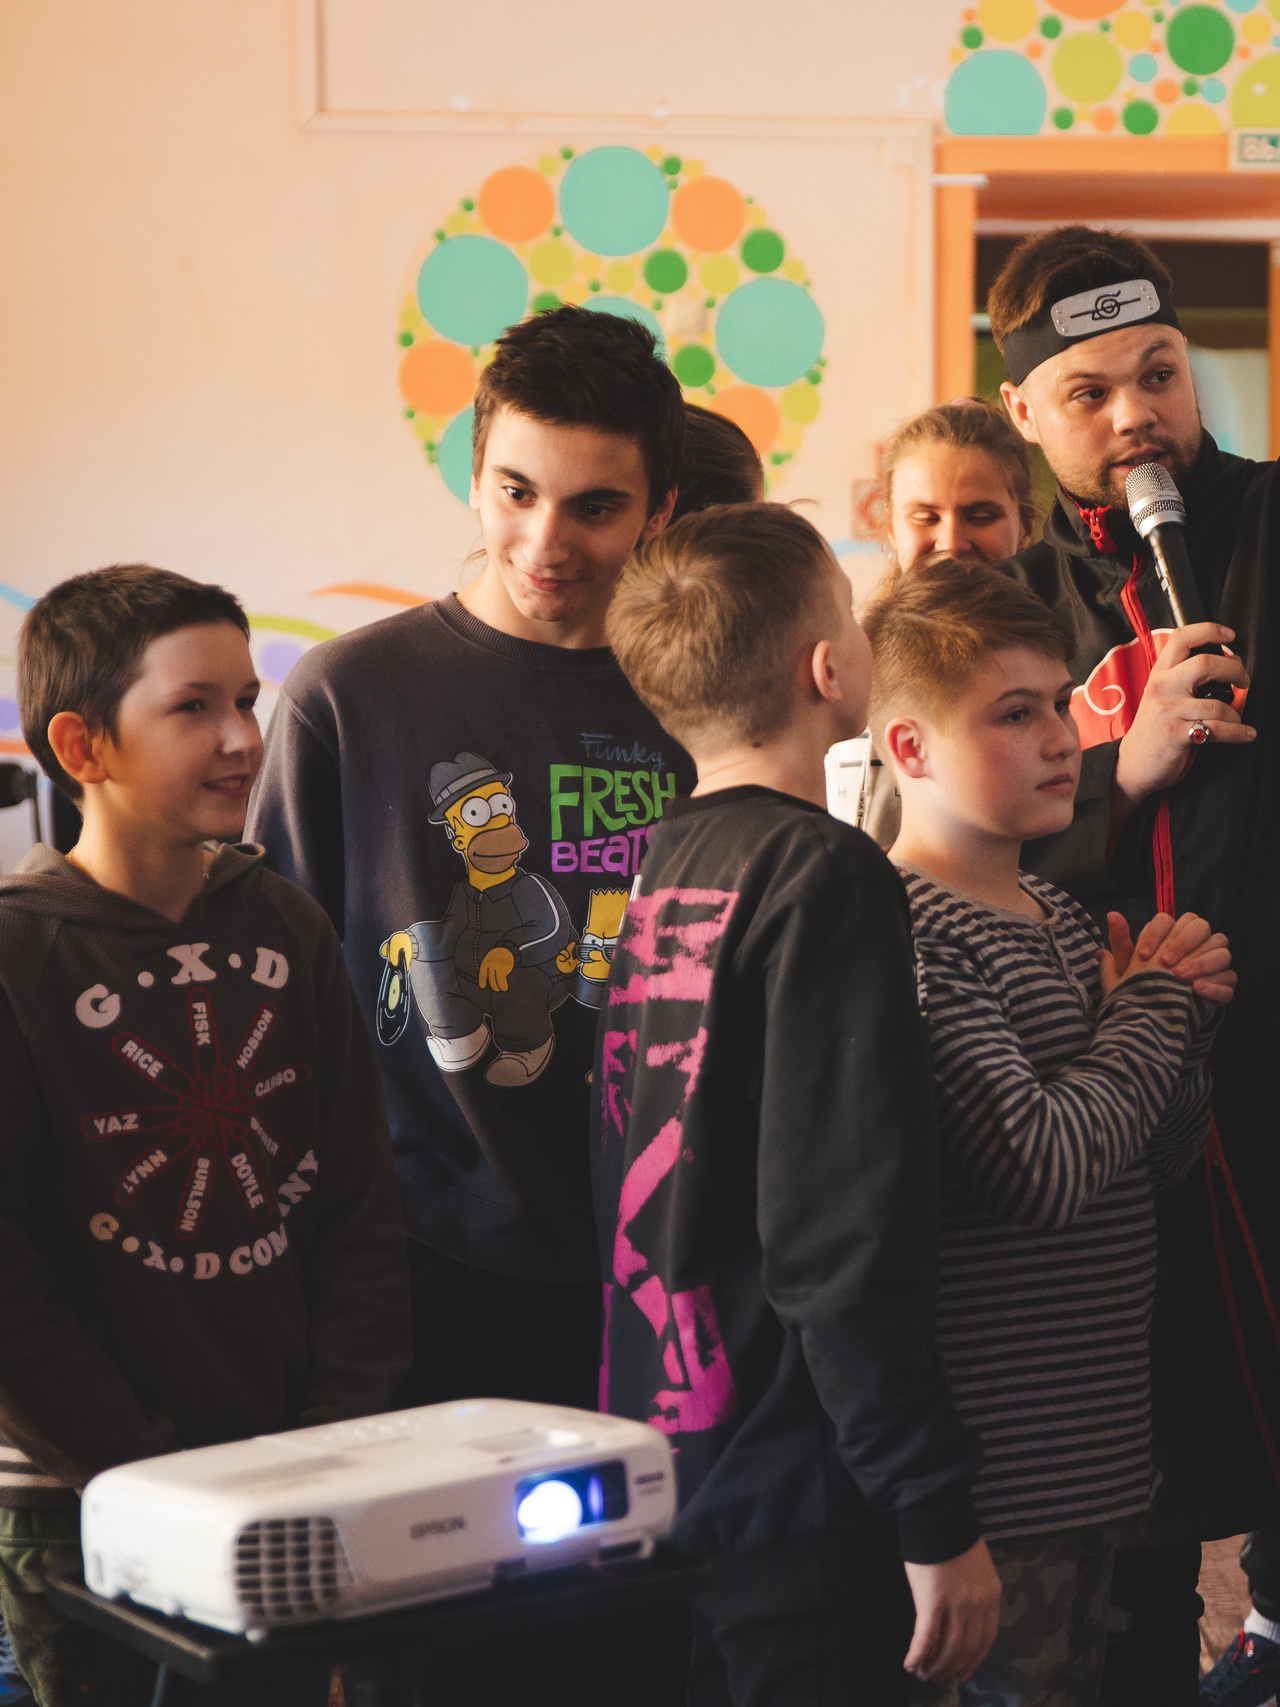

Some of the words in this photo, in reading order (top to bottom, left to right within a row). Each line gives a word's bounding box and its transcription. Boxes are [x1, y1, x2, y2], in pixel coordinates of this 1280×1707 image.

[550, 764, 675, 840] FRESH
[192, 1002, 211, 1046] FISK
[236, 1009, 273, 1068] HOBSON
[122, 1040, 163, 1078] RICE
[94, 1113, 138, 1134] YAZ
[122, 1149, 168, 1194] LYNN
[231, 1152, 264, 1209] DOYLE
